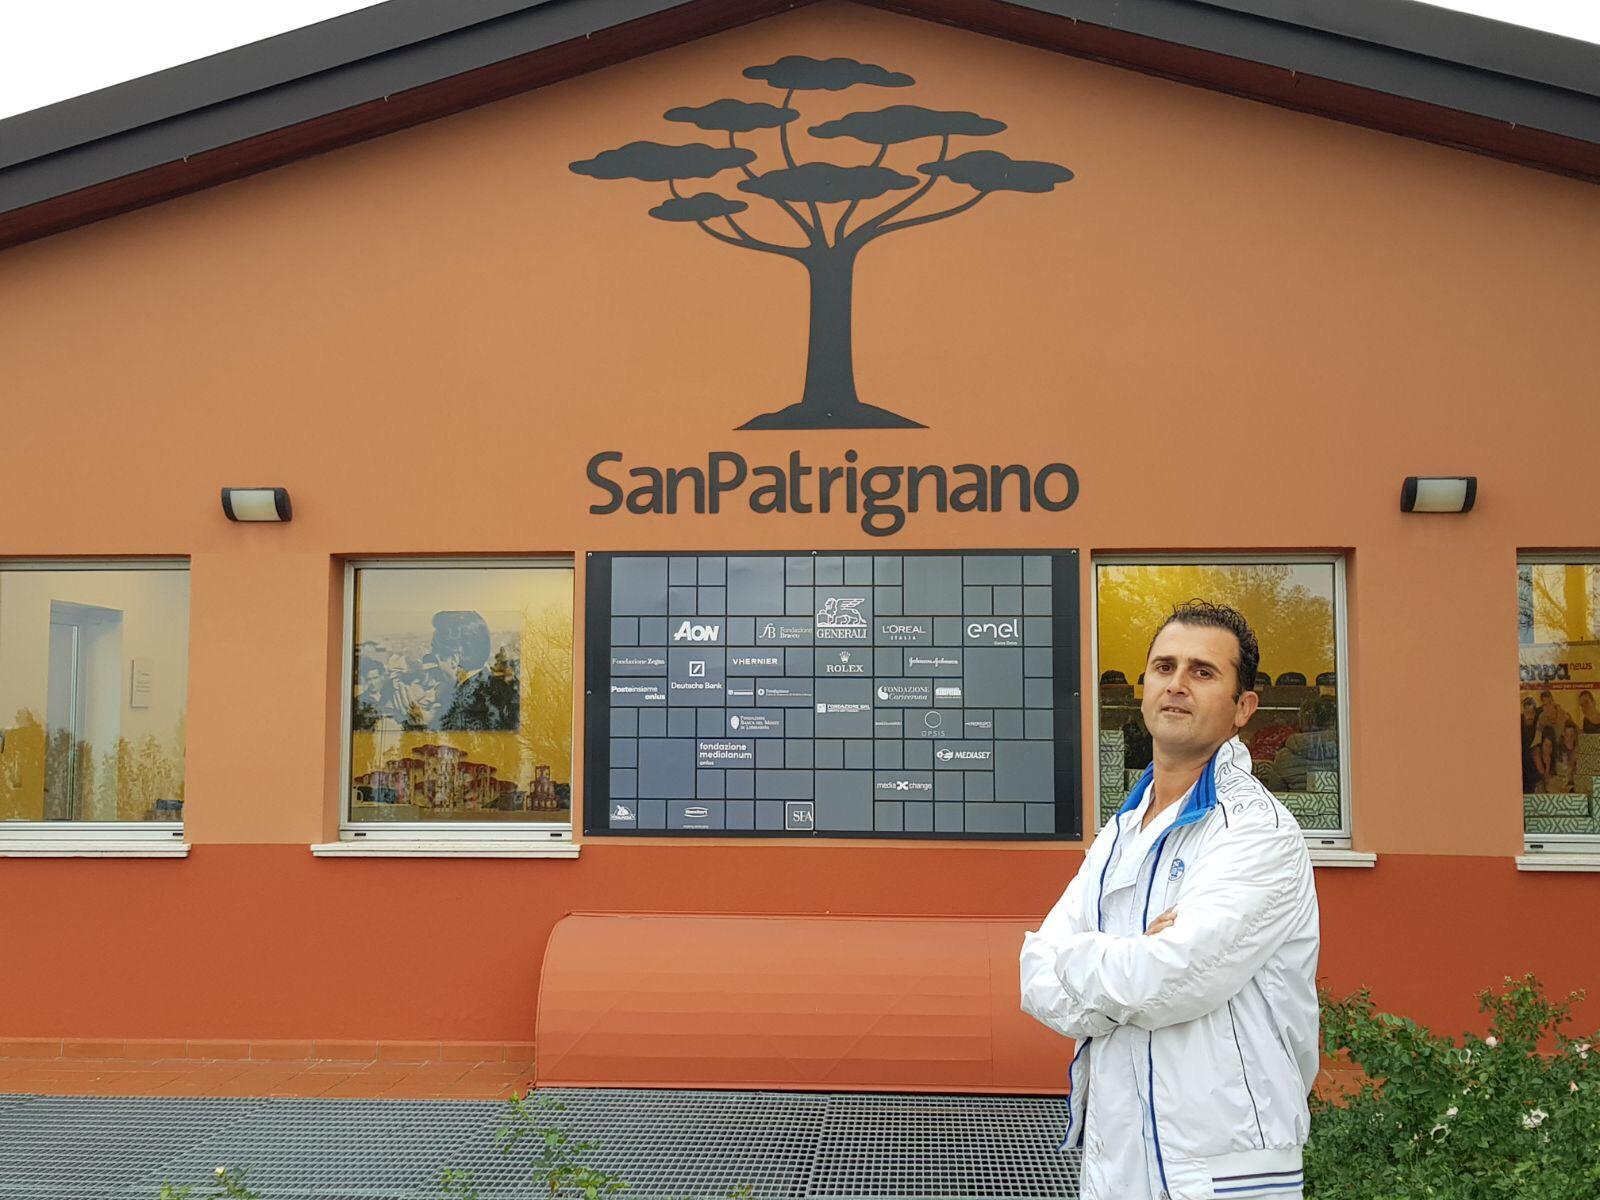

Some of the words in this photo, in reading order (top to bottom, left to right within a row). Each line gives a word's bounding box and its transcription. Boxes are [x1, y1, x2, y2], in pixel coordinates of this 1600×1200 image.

[586, 450, 1079, 537] SanPatrignano
[674, 620, 720, 641] AON
[967, 618, 1019, 639] enel
[816, 628, 867, 639] GENERALI
[826, 665, 864, 673] ROLEX
[1569, 662, 1593, 671] news
[671, 682, 704, 690] Deutsche
[704, 682, 723, 690] Bank
[700, 742, 747, 751] fondazione
[699, 751, 752, 759] mediolanum
[954, 751, 991, 759] MEDIASET
[793, 810, 813, 822] SEA
